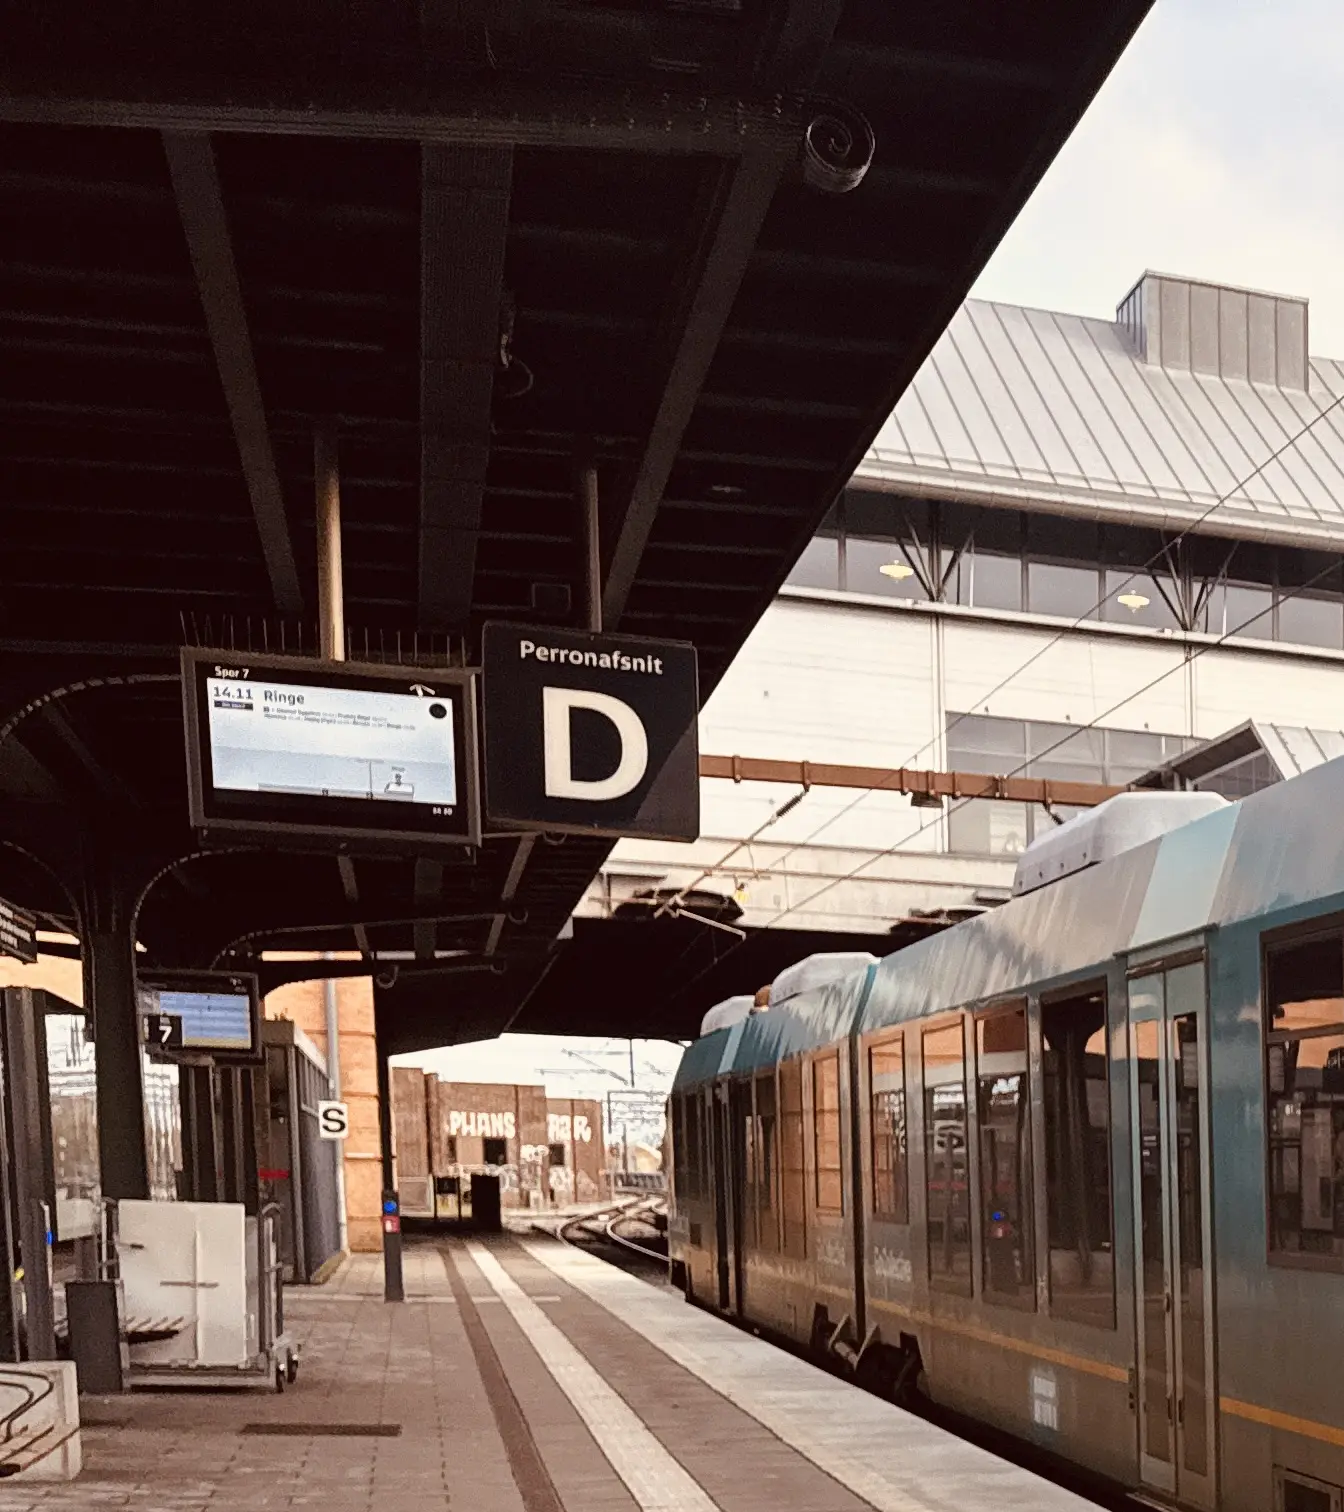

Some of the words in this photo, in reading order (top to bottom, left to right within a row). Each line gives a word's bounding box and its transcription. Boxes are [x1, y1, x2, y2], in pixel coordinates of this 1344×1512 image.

[520, 640, 663, 675] Perronafsnit
[215, 665, 240, 679] Spor
[242, 668, 250, 679] 7
[213, 686, 254, 700] 14.11
[264, 690, 305, 706] Ringe
[543, 686, 648, 800] D
[159, 1025, 172, 1043] 7
[322, 1108, 346, 1132] S
